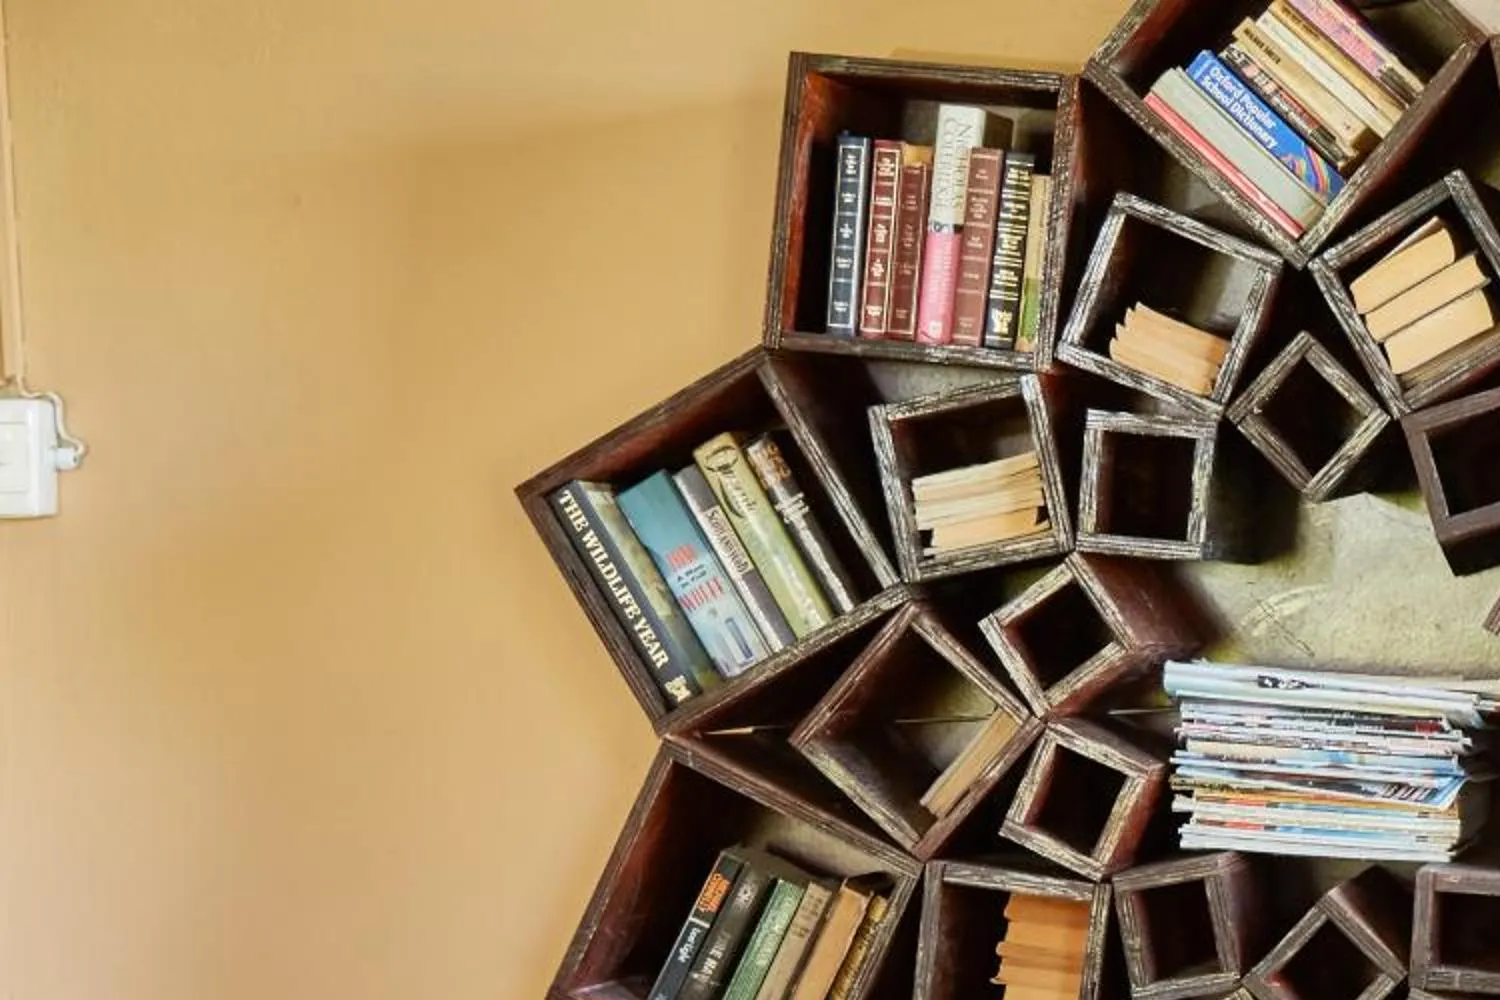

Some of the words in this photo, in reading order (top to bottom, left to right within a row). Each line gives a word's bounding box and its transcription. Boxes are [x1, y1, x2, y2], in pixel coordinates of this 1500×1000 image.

[1200, 74, 1234, 107] School
[1228, 102, 1278, 149] Dictionary
[1208, 64, 1245, 98] Oxford
[1238, 93, 1278, 130] Popular
[555, 488, 590, 532] THE
[579, 529, 642, 620] WILDLIFE
[632, 617, 671, 669] YEAR
